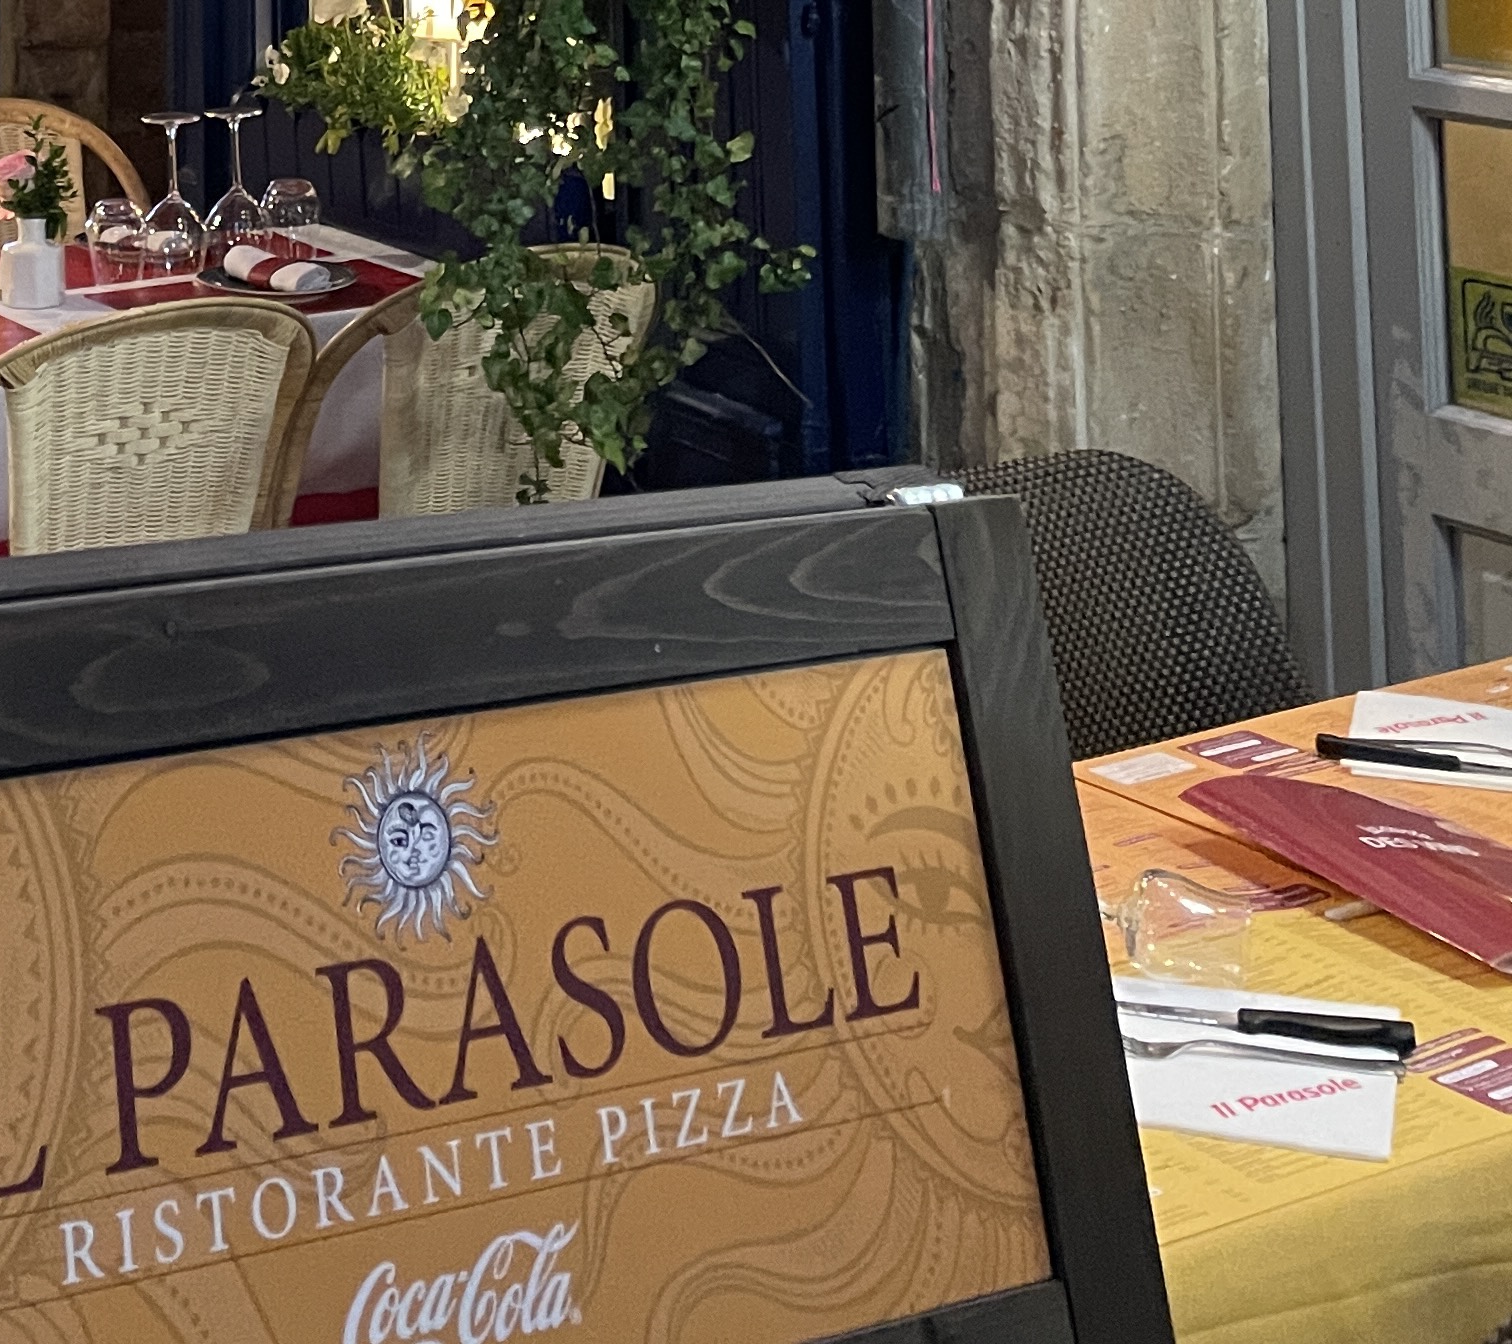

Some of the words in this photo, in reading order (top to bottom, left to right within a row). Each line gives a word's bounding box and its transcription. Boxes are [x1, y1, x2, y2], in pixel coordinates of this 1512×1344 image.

[94, 866, 920, 1176] PARASOLE
[1210, 1101, 1237, 1118] Il
[1237, 1078, 1362, 1112] Parasole
[60, 1118, 564, 1286] RISTORANTE
[601, 1069, 805, 1164] PIZZA
[342, 1218, 578, 1344] Coca-Cola
